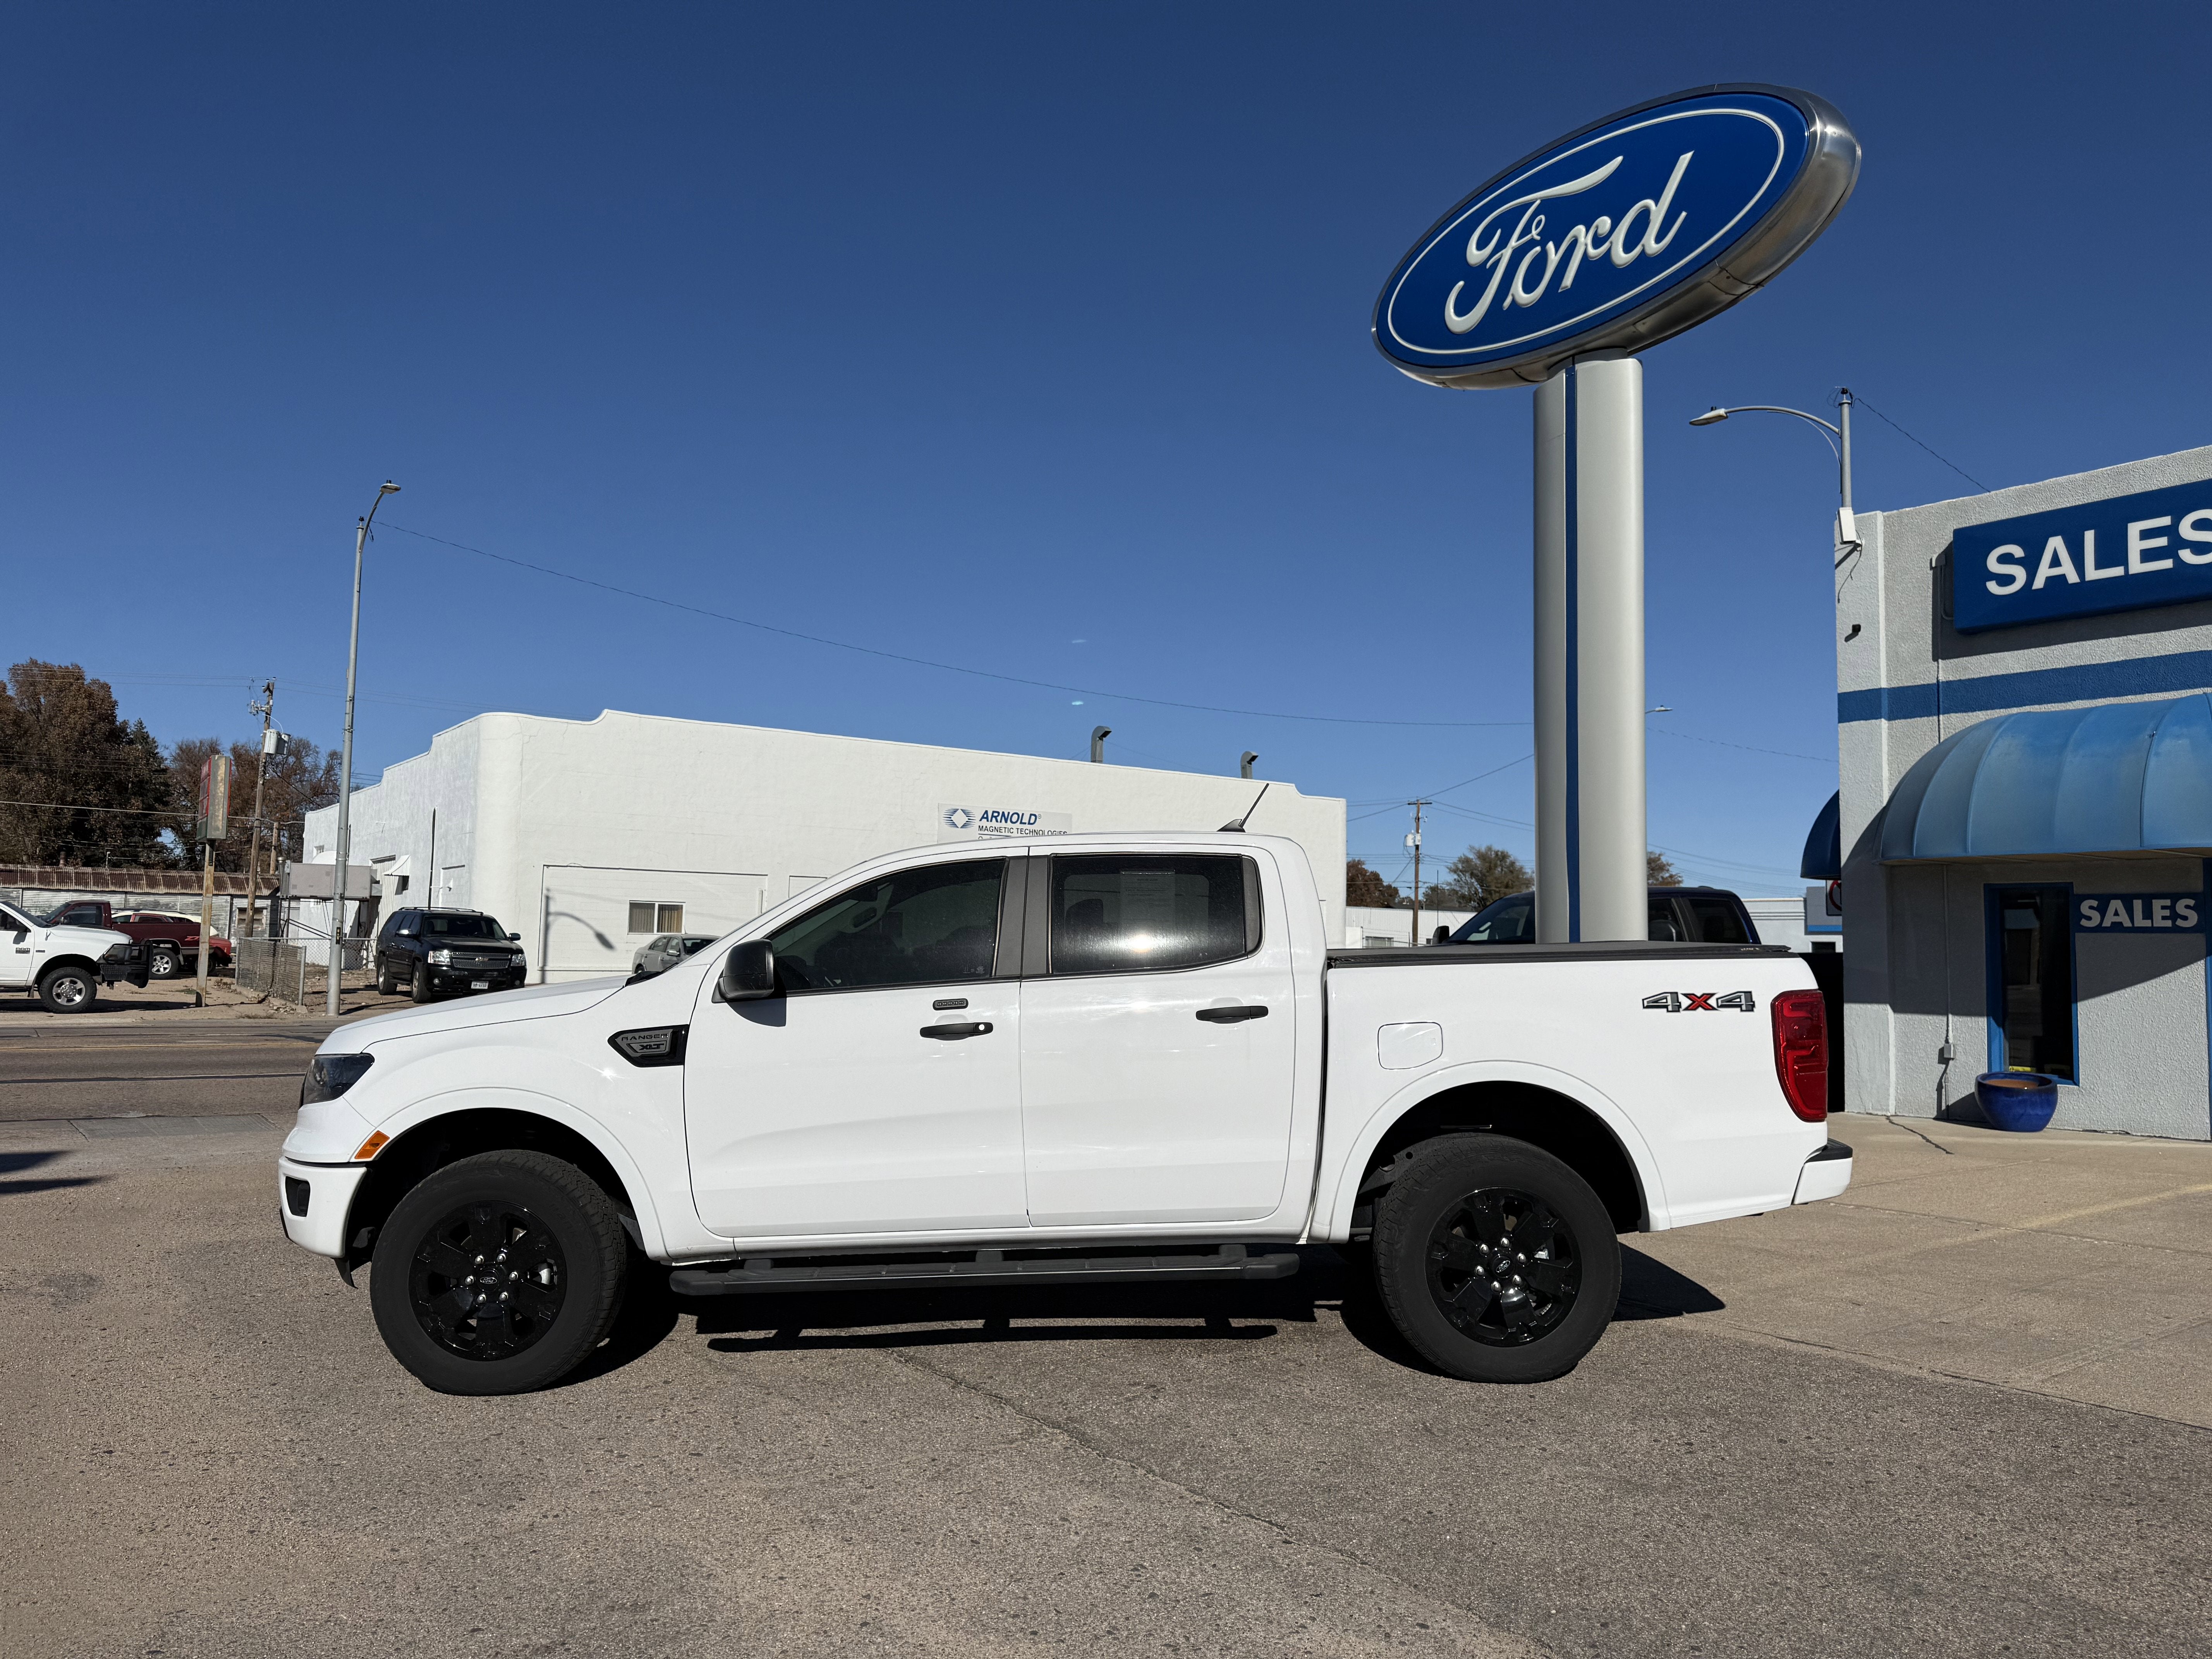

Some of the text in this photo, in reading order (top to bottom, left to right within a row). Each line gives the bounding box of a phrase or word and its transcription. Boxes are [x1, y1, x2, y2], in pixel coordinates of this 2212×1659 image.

[1444, 150, 1695, 335] Ford
[1985, 508, 2212, 596] SALES
[979, 810, 1037, 825] ARNOLD
[978, 825, 1014, 834] MAGNETIC
[2080, 898, 2198, 928] SALES
[622, 1033, 668, 1041] RANGER
